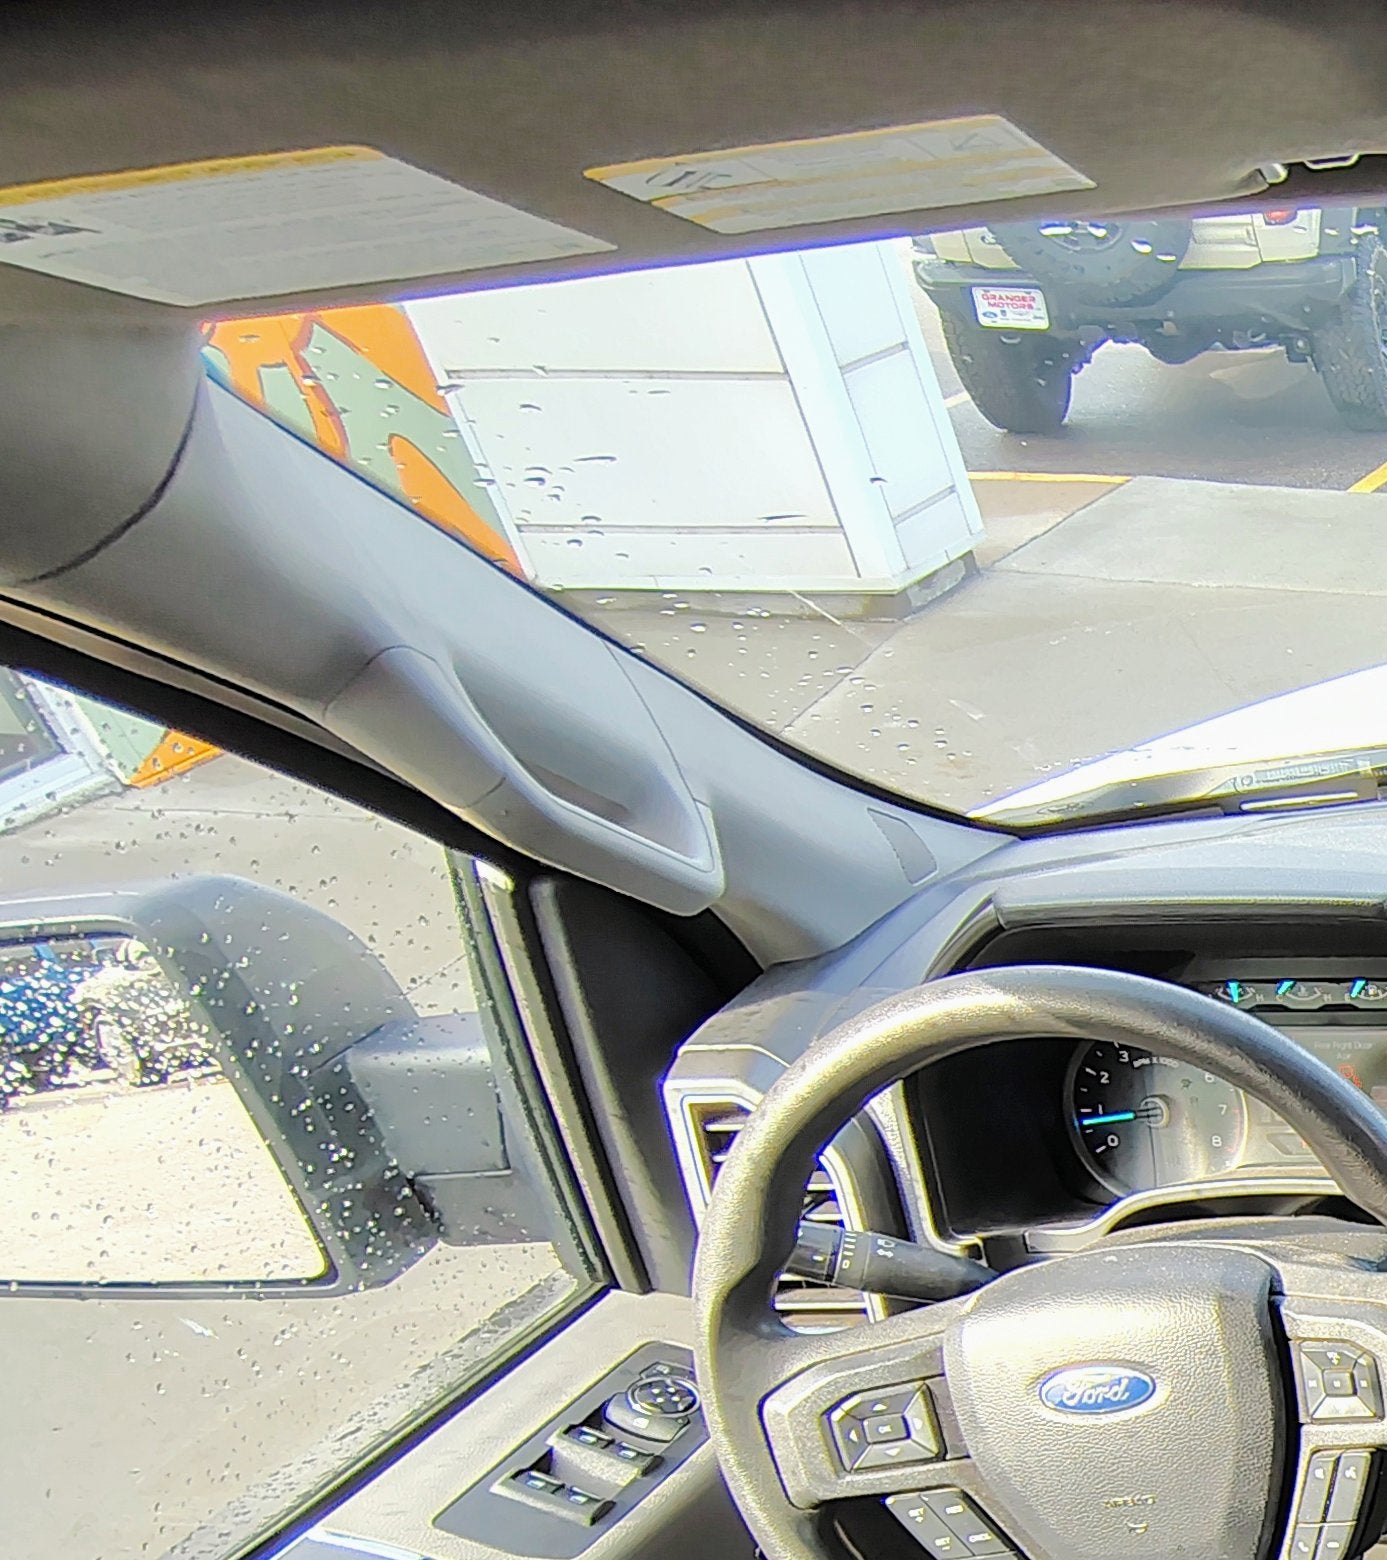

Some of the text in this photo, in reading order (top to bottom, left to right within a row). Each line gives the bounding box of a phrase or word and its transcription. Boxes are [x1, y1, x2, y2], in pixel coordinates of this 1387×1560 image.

[981, 293, 1036, 303] GRANGER
[987, 301, 1034, 310] MOTORS
[1118, 1051, 1129, 1062] 3
[1100, 1072, 1110, 1084] 2
[1204, 1073, 1215, 1083] 6
[1218, 1104, 1228, 1115] 7
[1107, 1135, 1119, 1147] 0
[1211, 1135, 1222, 1147] 8
[1062, 1376, 1130, 1407] Ford
[907, 1507, 925, 1518] SET
[934, 1536, 952, 1547] SET
